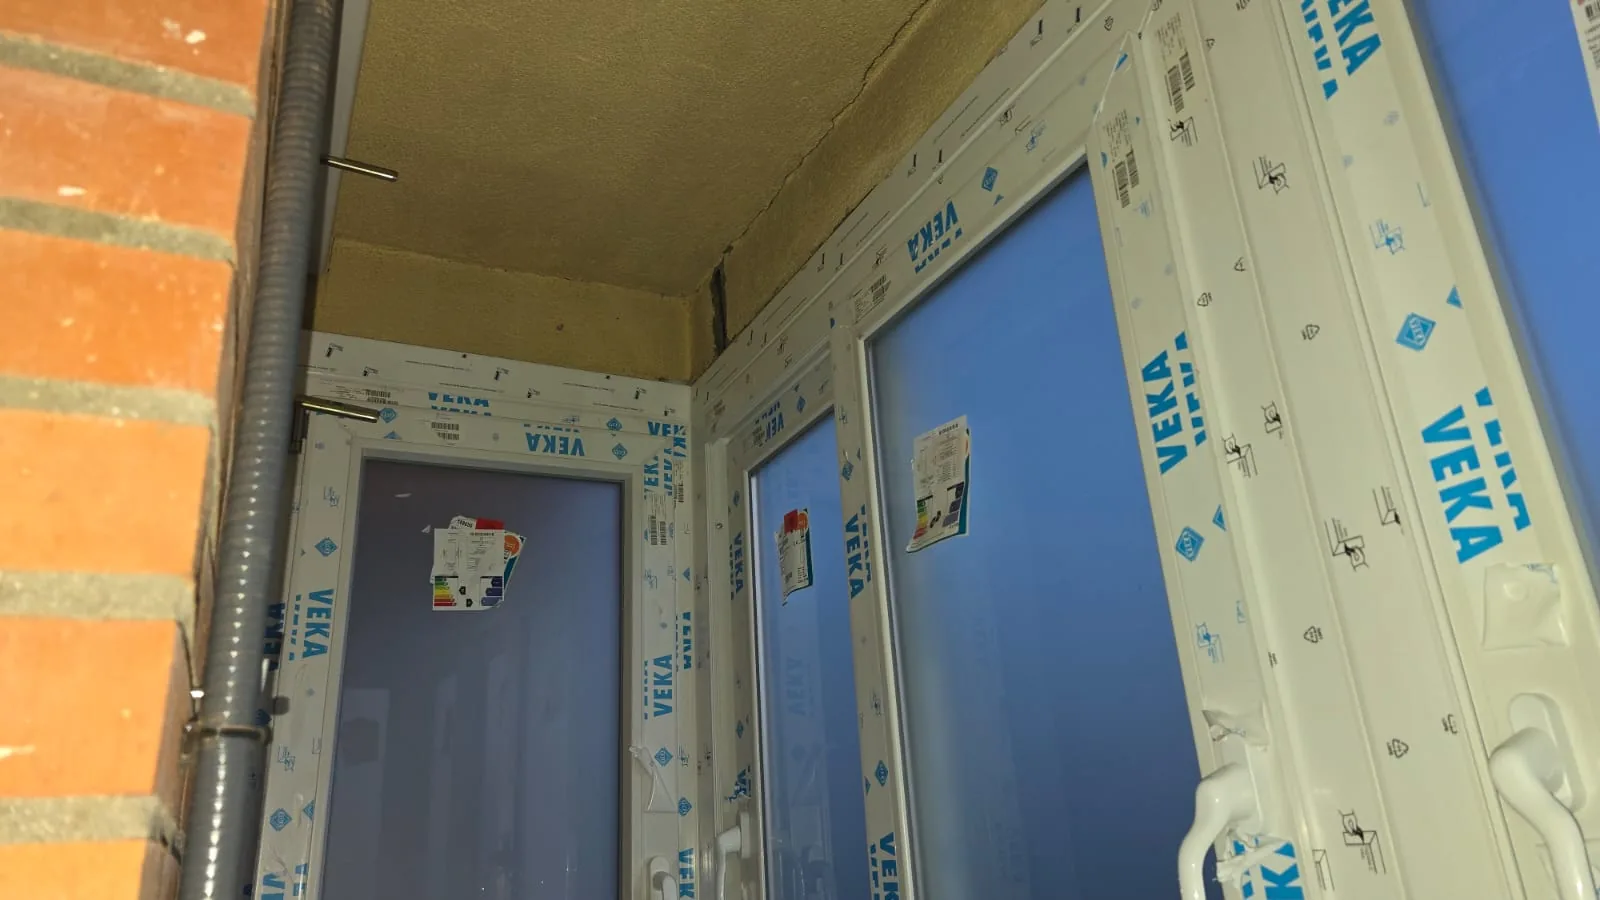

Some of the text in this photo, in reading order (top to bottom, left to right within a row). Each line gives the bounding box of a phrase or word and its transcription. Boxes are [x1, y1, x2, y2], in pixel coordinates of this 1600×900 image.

[907, 200, 961, 262] VEKA
[523, 432, 585, 457] VEKA
[1140, 350, 1190, 475] VEKA
[1420, 404, 1504, 565] VEKA
[734, 530, 744, 594] VEKA
[841, 514, 865, 600] VEKA
[302, 588, 335, 659] VEKA
[652, 653, 674, 718] VEKA
